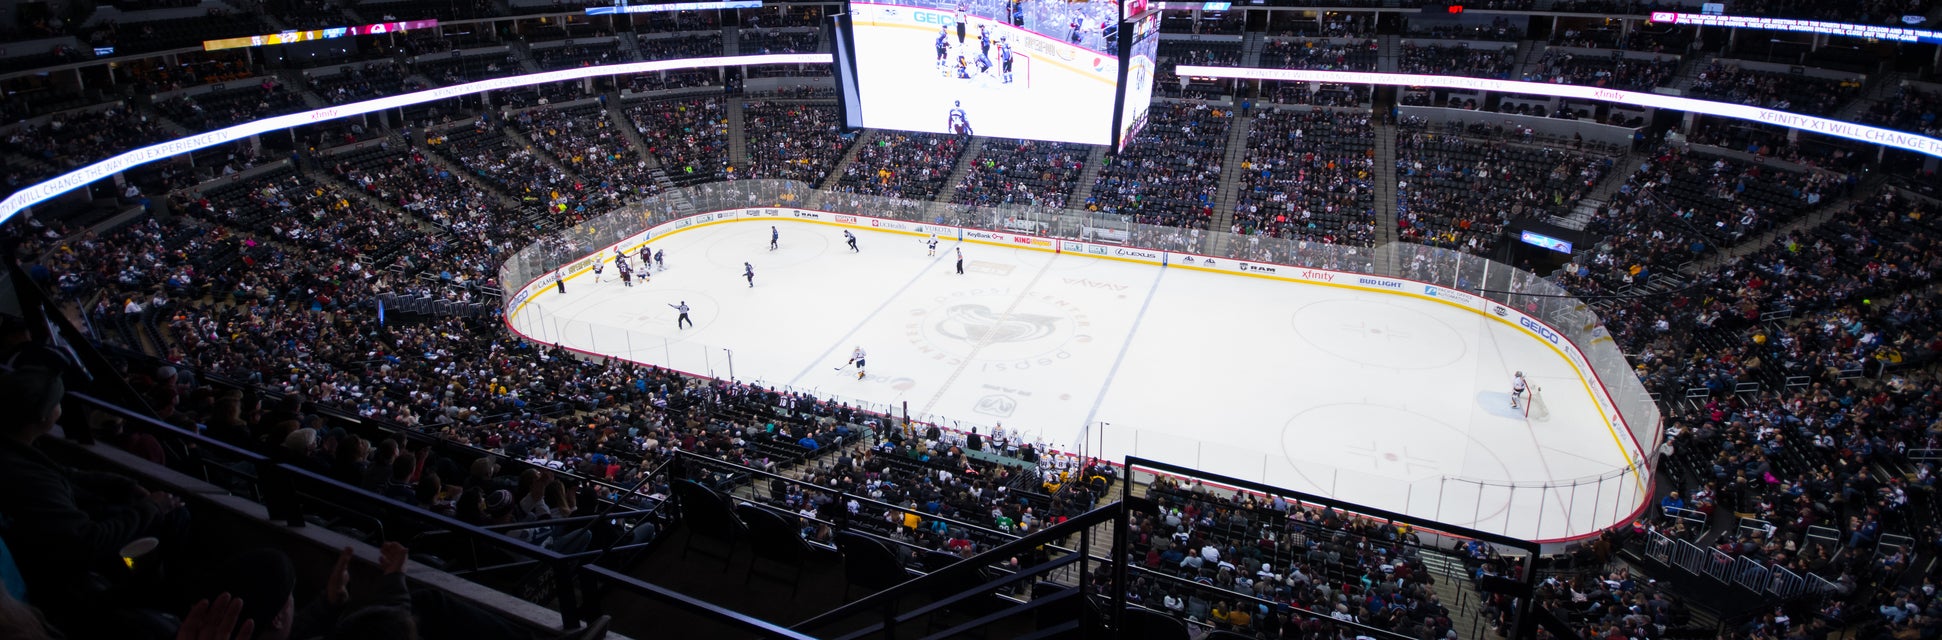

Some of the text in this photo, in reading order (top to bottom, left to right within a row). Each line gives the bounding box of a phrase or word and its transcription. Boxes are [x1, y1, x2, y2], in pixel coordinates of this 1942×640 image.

[627, 4, 663, 12] WELCOME
[1887, 34, 1917, 42] FIVE-GAME
[1244, 70, 1280, 79] XFINITY
[1293, 72, 1313, 80] WILL
[1315, 73, 1352, 81] CHANGE
[1378, 75, 1396, 83] WAY
[1423, 77, 1485, 87] EXPERIENCE
[432, 85, 463, 97] XFINITY
[1593, 89, 1625, 101] xfinity
[311, 108, 338, 121] xfinity
[1758, 110, 1808, 127] XFINITY
[1811, 118, 1825, 131] X1
[1829, 122, 1860, 138] WILL
[1865, 129, 1926, 150] CHANGE
[18, 188, 41, 206] WILL
[43, 173, 84, 196] CHANGE
[85, 164, 103, 179] THE
[105, 157, 122, 172] WAY
[123, 153, 145, 165] YOU
[147, 133, 214, 159] EXPERIENCE
[216, 130, 229, 142] TV
[924, 225, 952, 234] VUKOTA
[967, 231, 991, 240] KeyBank
[1014, 236, 1031, 245] KING
[1126, 251, 1156, 259] LEXUS
[1251, 265, 1276, 273] RAM
[538, 271, 566, 289] CAMBA
[1302, 269, 1335, 282] xfinity
[1062, 278, 1129, 292] AVAYA
[1359, 277, 1402, 288] BUD LIGHT
[1520, 316, 1559, 345] GEICO
